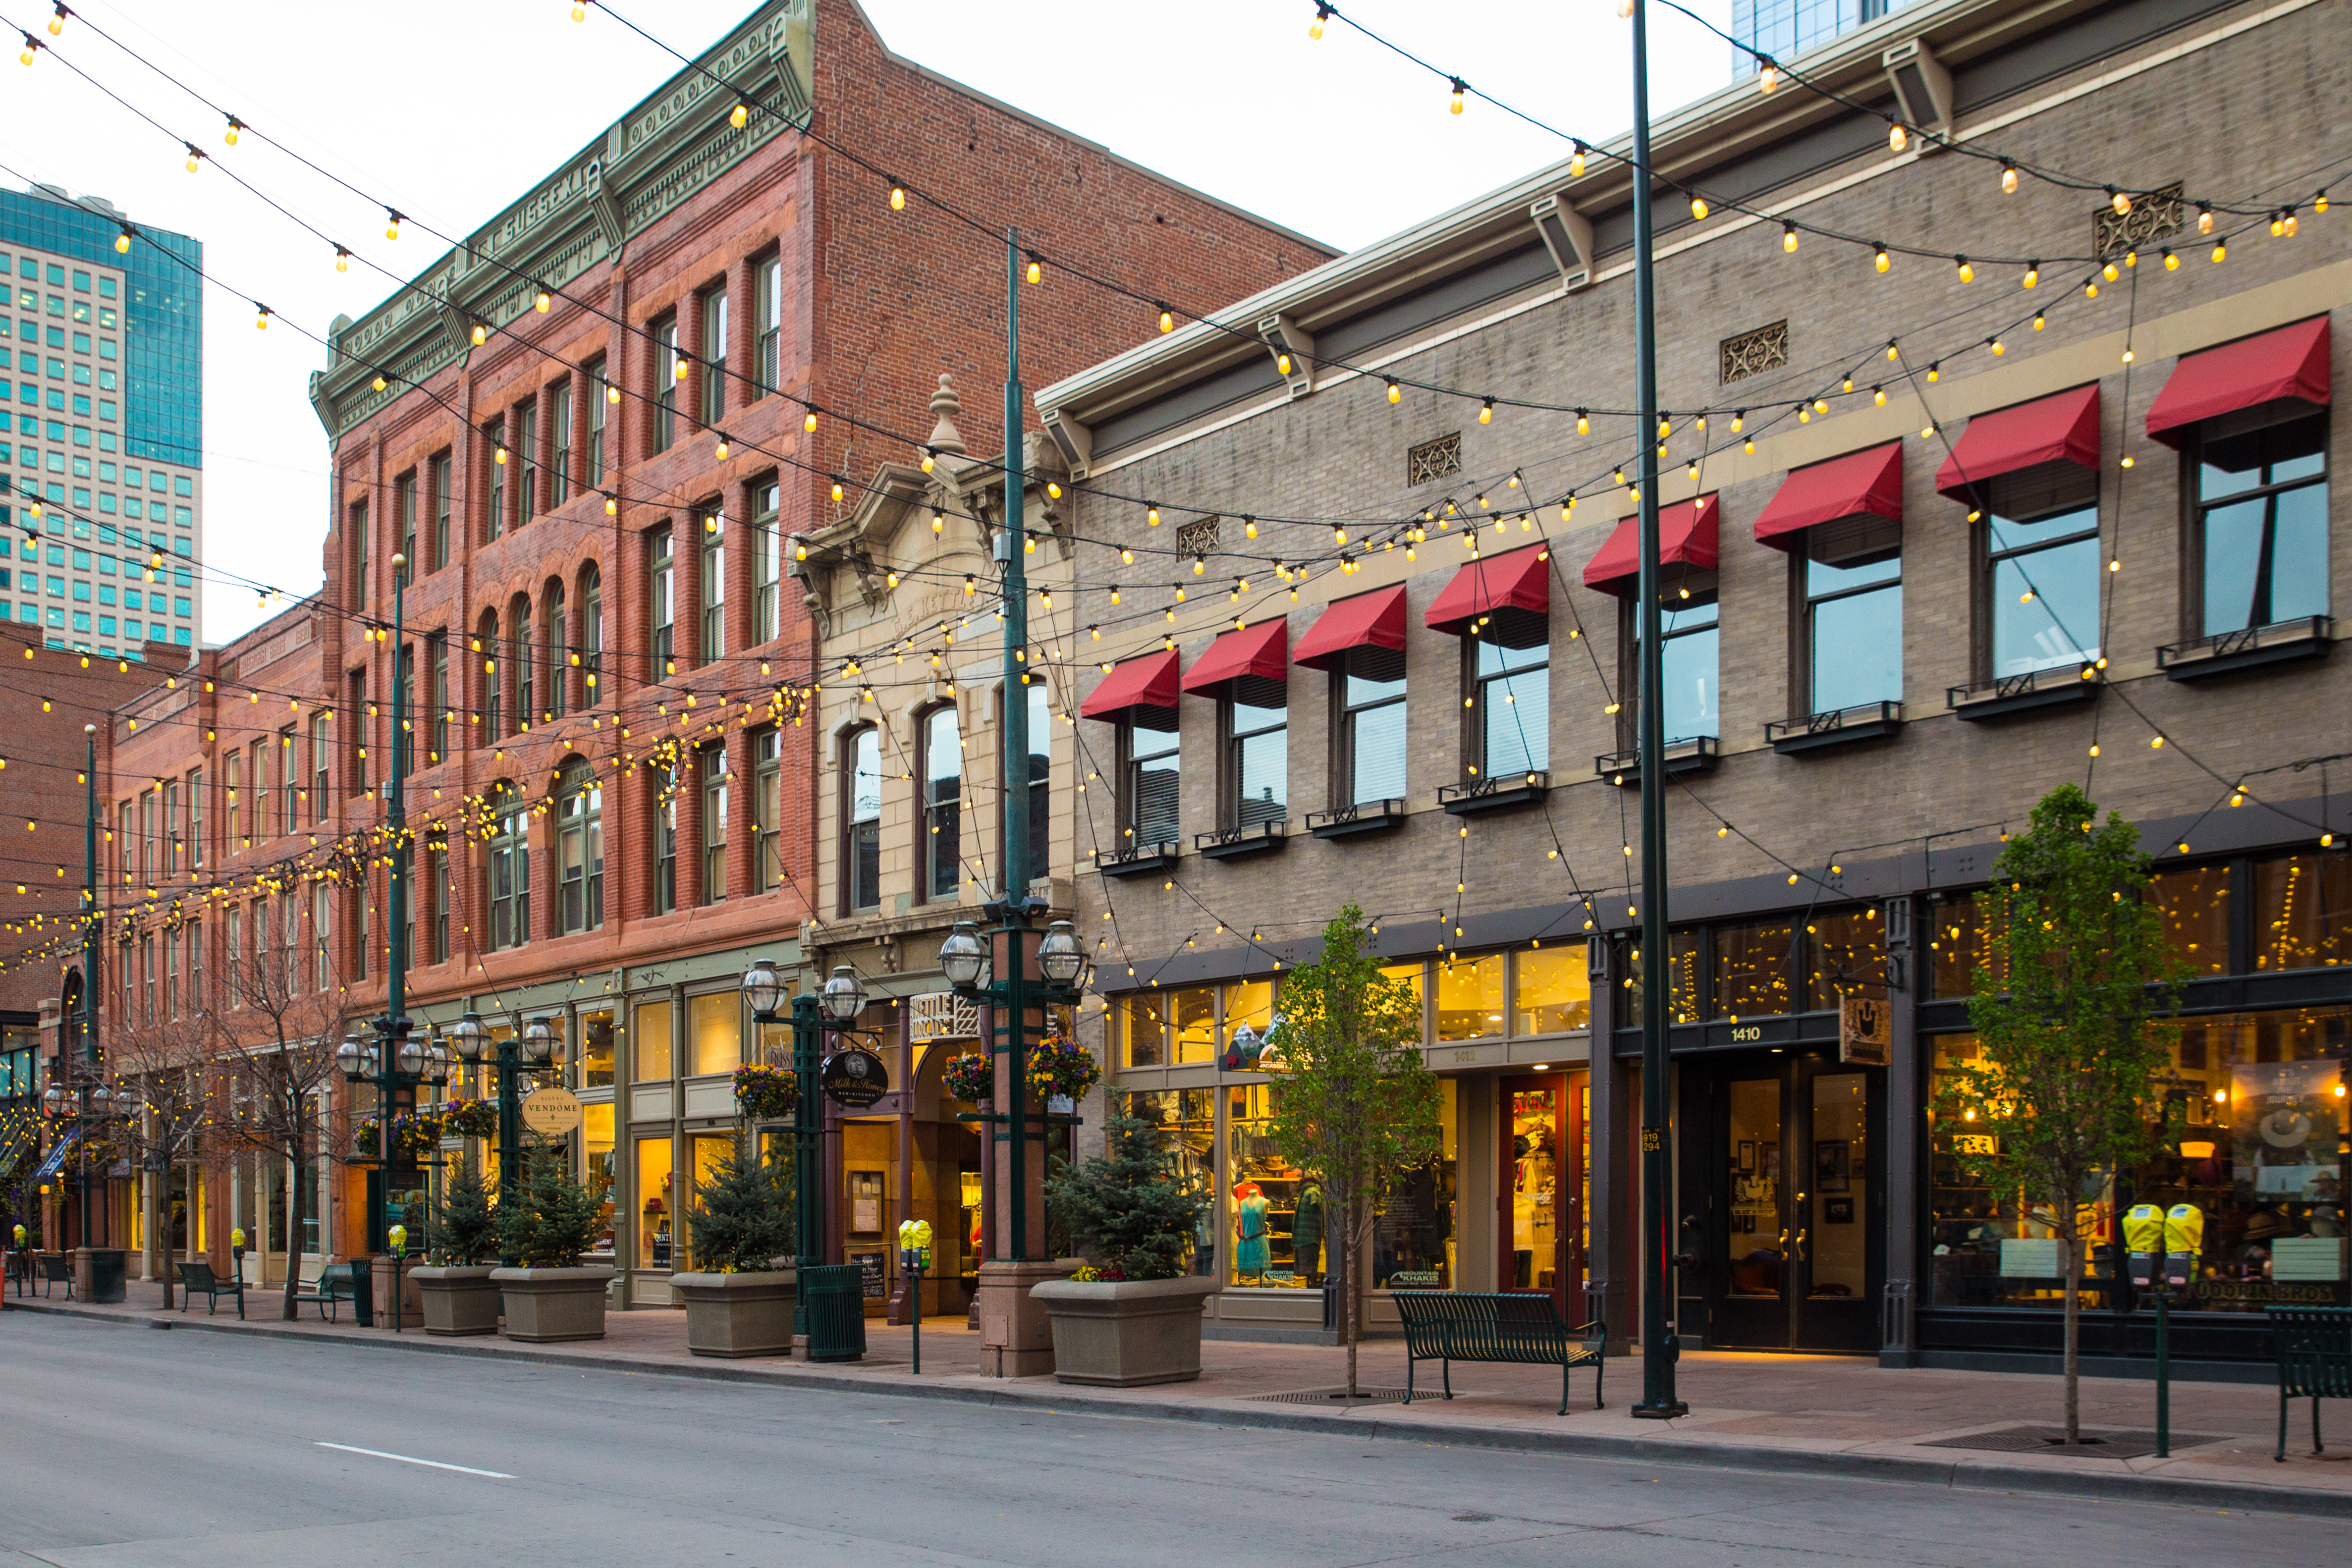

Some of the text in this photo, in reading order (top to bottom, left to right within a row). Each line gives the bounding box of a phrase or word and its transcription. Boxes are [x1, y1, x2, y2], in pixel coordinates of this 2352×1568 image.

[503, 172, 572, 243] SUSSEX
[1731, 1027, 1760, 1041] 1410
[1454, 1050, 1475, 1062] 1412
[529, 1102, 577, 1112] VENDÔME
[1643, 1134, 1658, 1142] 919
[1643, 1142, 1660, 1151] 294
